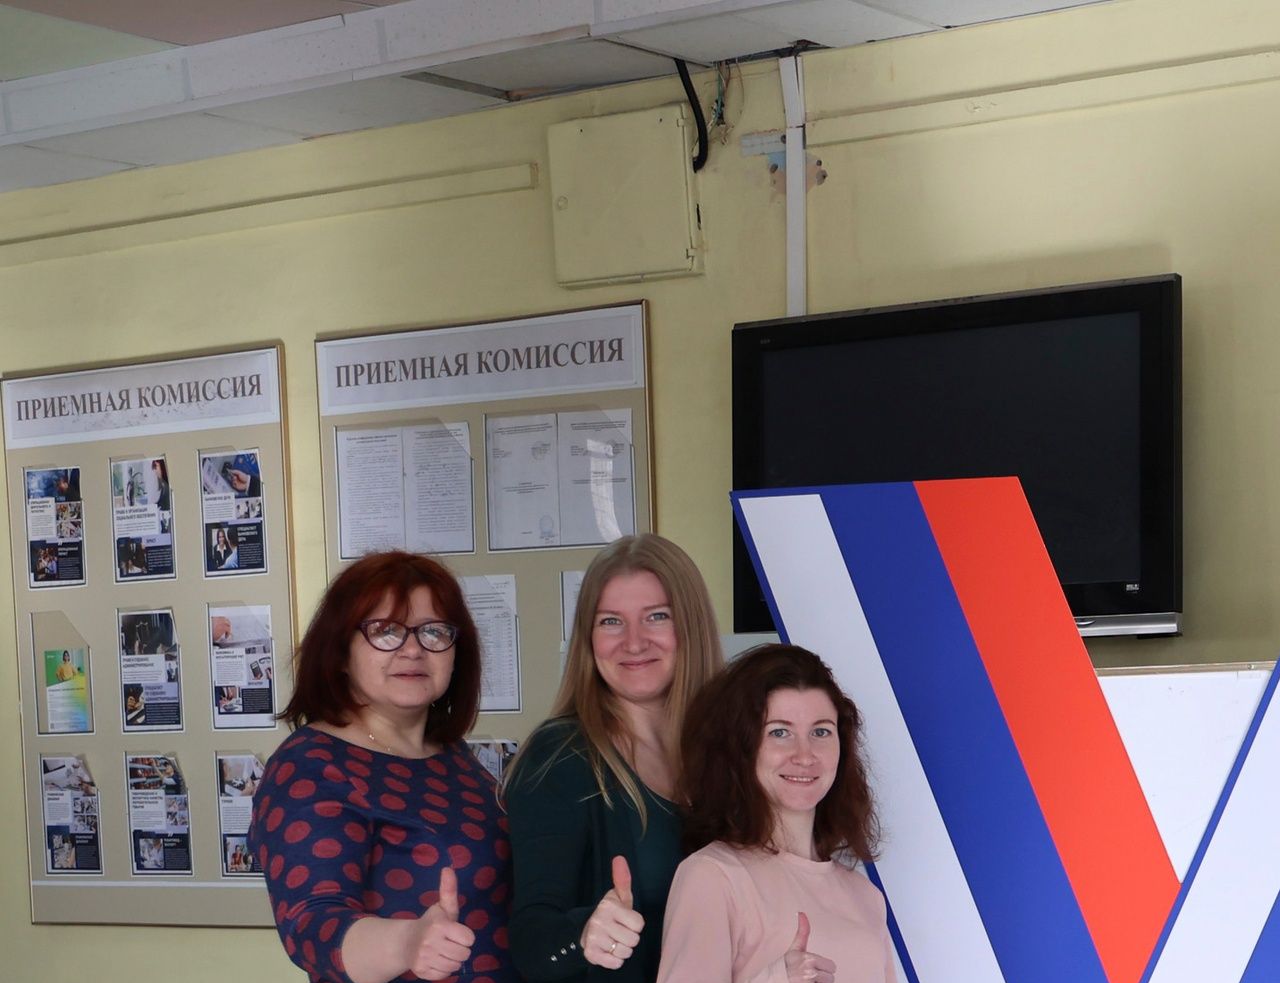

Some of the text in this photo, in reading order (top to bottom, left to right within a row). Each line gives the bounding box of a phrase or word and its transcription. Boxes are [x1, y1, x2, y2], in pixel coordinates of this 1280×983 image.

[335, 337, 625, 388] ПРИЕМНАЯ КОМИССИЯ
[15, 373, 262, 422] ПРИЕМНАЯ КОМИССИЯ
